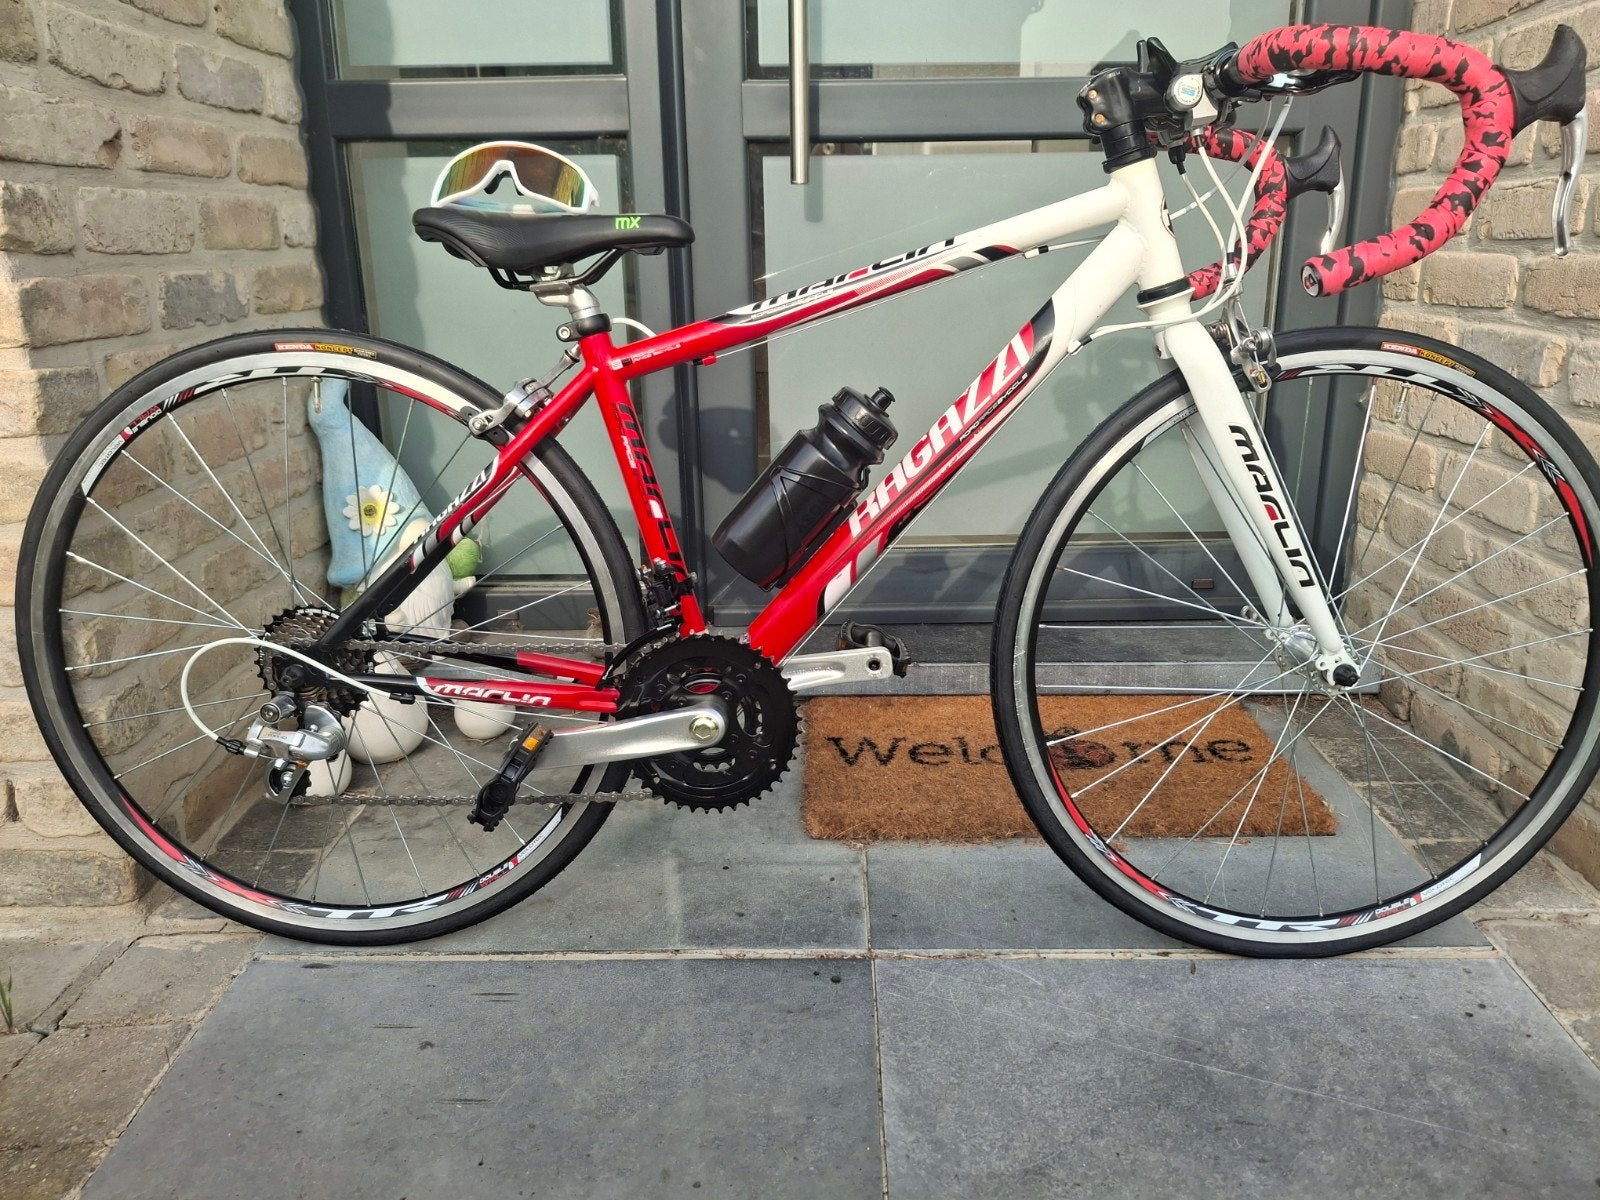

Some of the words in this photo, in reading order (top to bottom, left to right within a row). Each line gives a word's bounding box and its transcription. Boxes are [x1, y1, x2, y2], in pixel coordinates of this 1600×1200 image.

[276, 343, 314, 352] KENDA
[1382, 343, 1419, 356] KENDA
[1419, 349, 1456, 367] KONCEPT
[849, 331, 1030, 538] RAGAZZI
